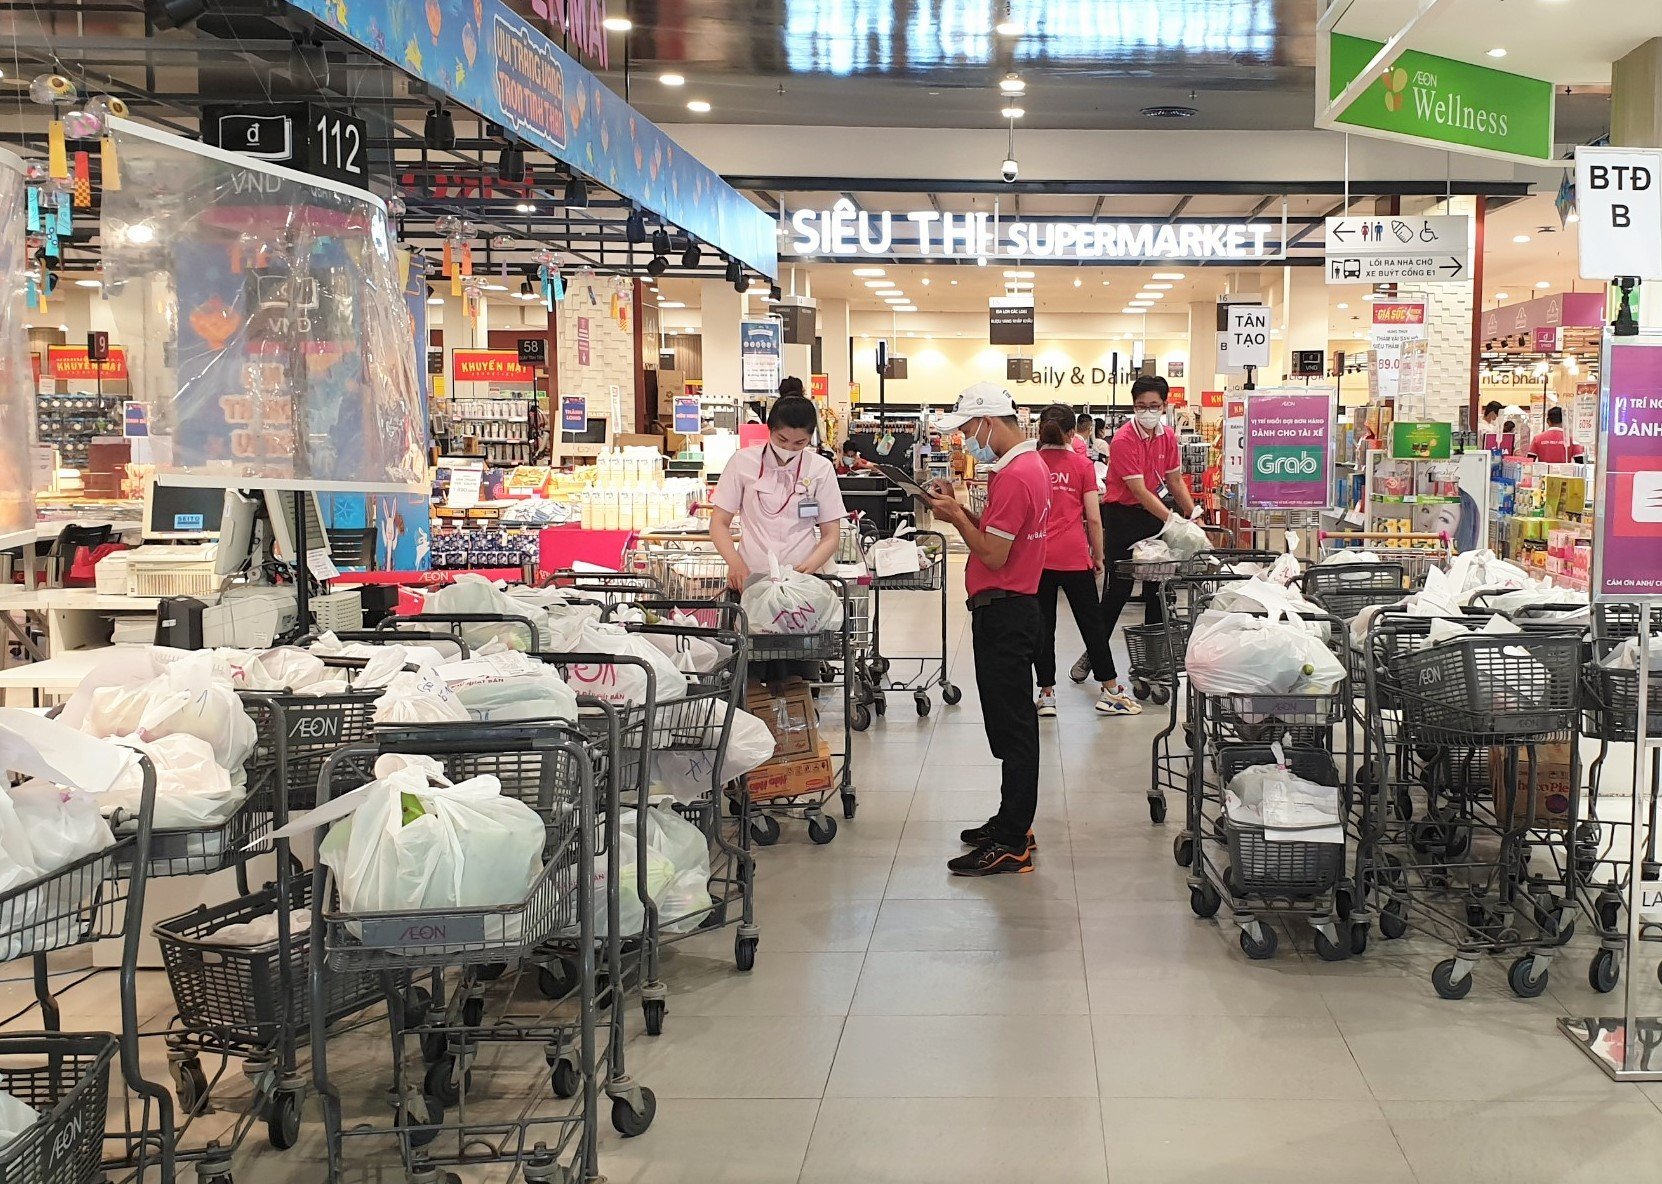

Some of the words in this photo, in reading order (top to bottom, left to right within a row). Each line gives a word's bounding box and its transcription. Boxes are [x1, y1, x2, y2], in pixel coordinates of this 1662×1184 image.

[1413, 86, 1508, 136] Wellness
[317, 115, 361, 175] 112
[231, 170, 281, 193] VND
[1590, 165, 1651, 191] BTĐ
[1611, 204, 1631, 228] B
[792, 198, 891, 254] SIÊU
[907, 210, 990, 266] THỊ
[1006, 221, 1271, 258] SUPERMARKET
[1384, 259, 1395, 268] RA
[1366, 269, 1376, 278] XE
[1426, 268, 1436, 277] E1
[1235, 313, 1265, 328] TÂN
[99, 336, 106, 353] 9
[523, 340, 539, 353] 58
[1220, 342, 1228, 351] B
[1234, 333, 1265, 348] TẠO
[461, 359, 503, 373] KHUYẾN
[1378, 358, 1400, 370] 89.0
[1070, 366, 1084, 384] &
[1092, 366, 1132, 384] Dair
[1630, 396, 1648, 408] TRÍ
[1252, 427, 1275, 437] DÀNH
[1277, 429, 1296, 437] CHO
[1298, 428, 1311, 437] TÀI
[1313, 427, 1324, 437] XẾ
[1257, 451, 1317, 474] Grab
